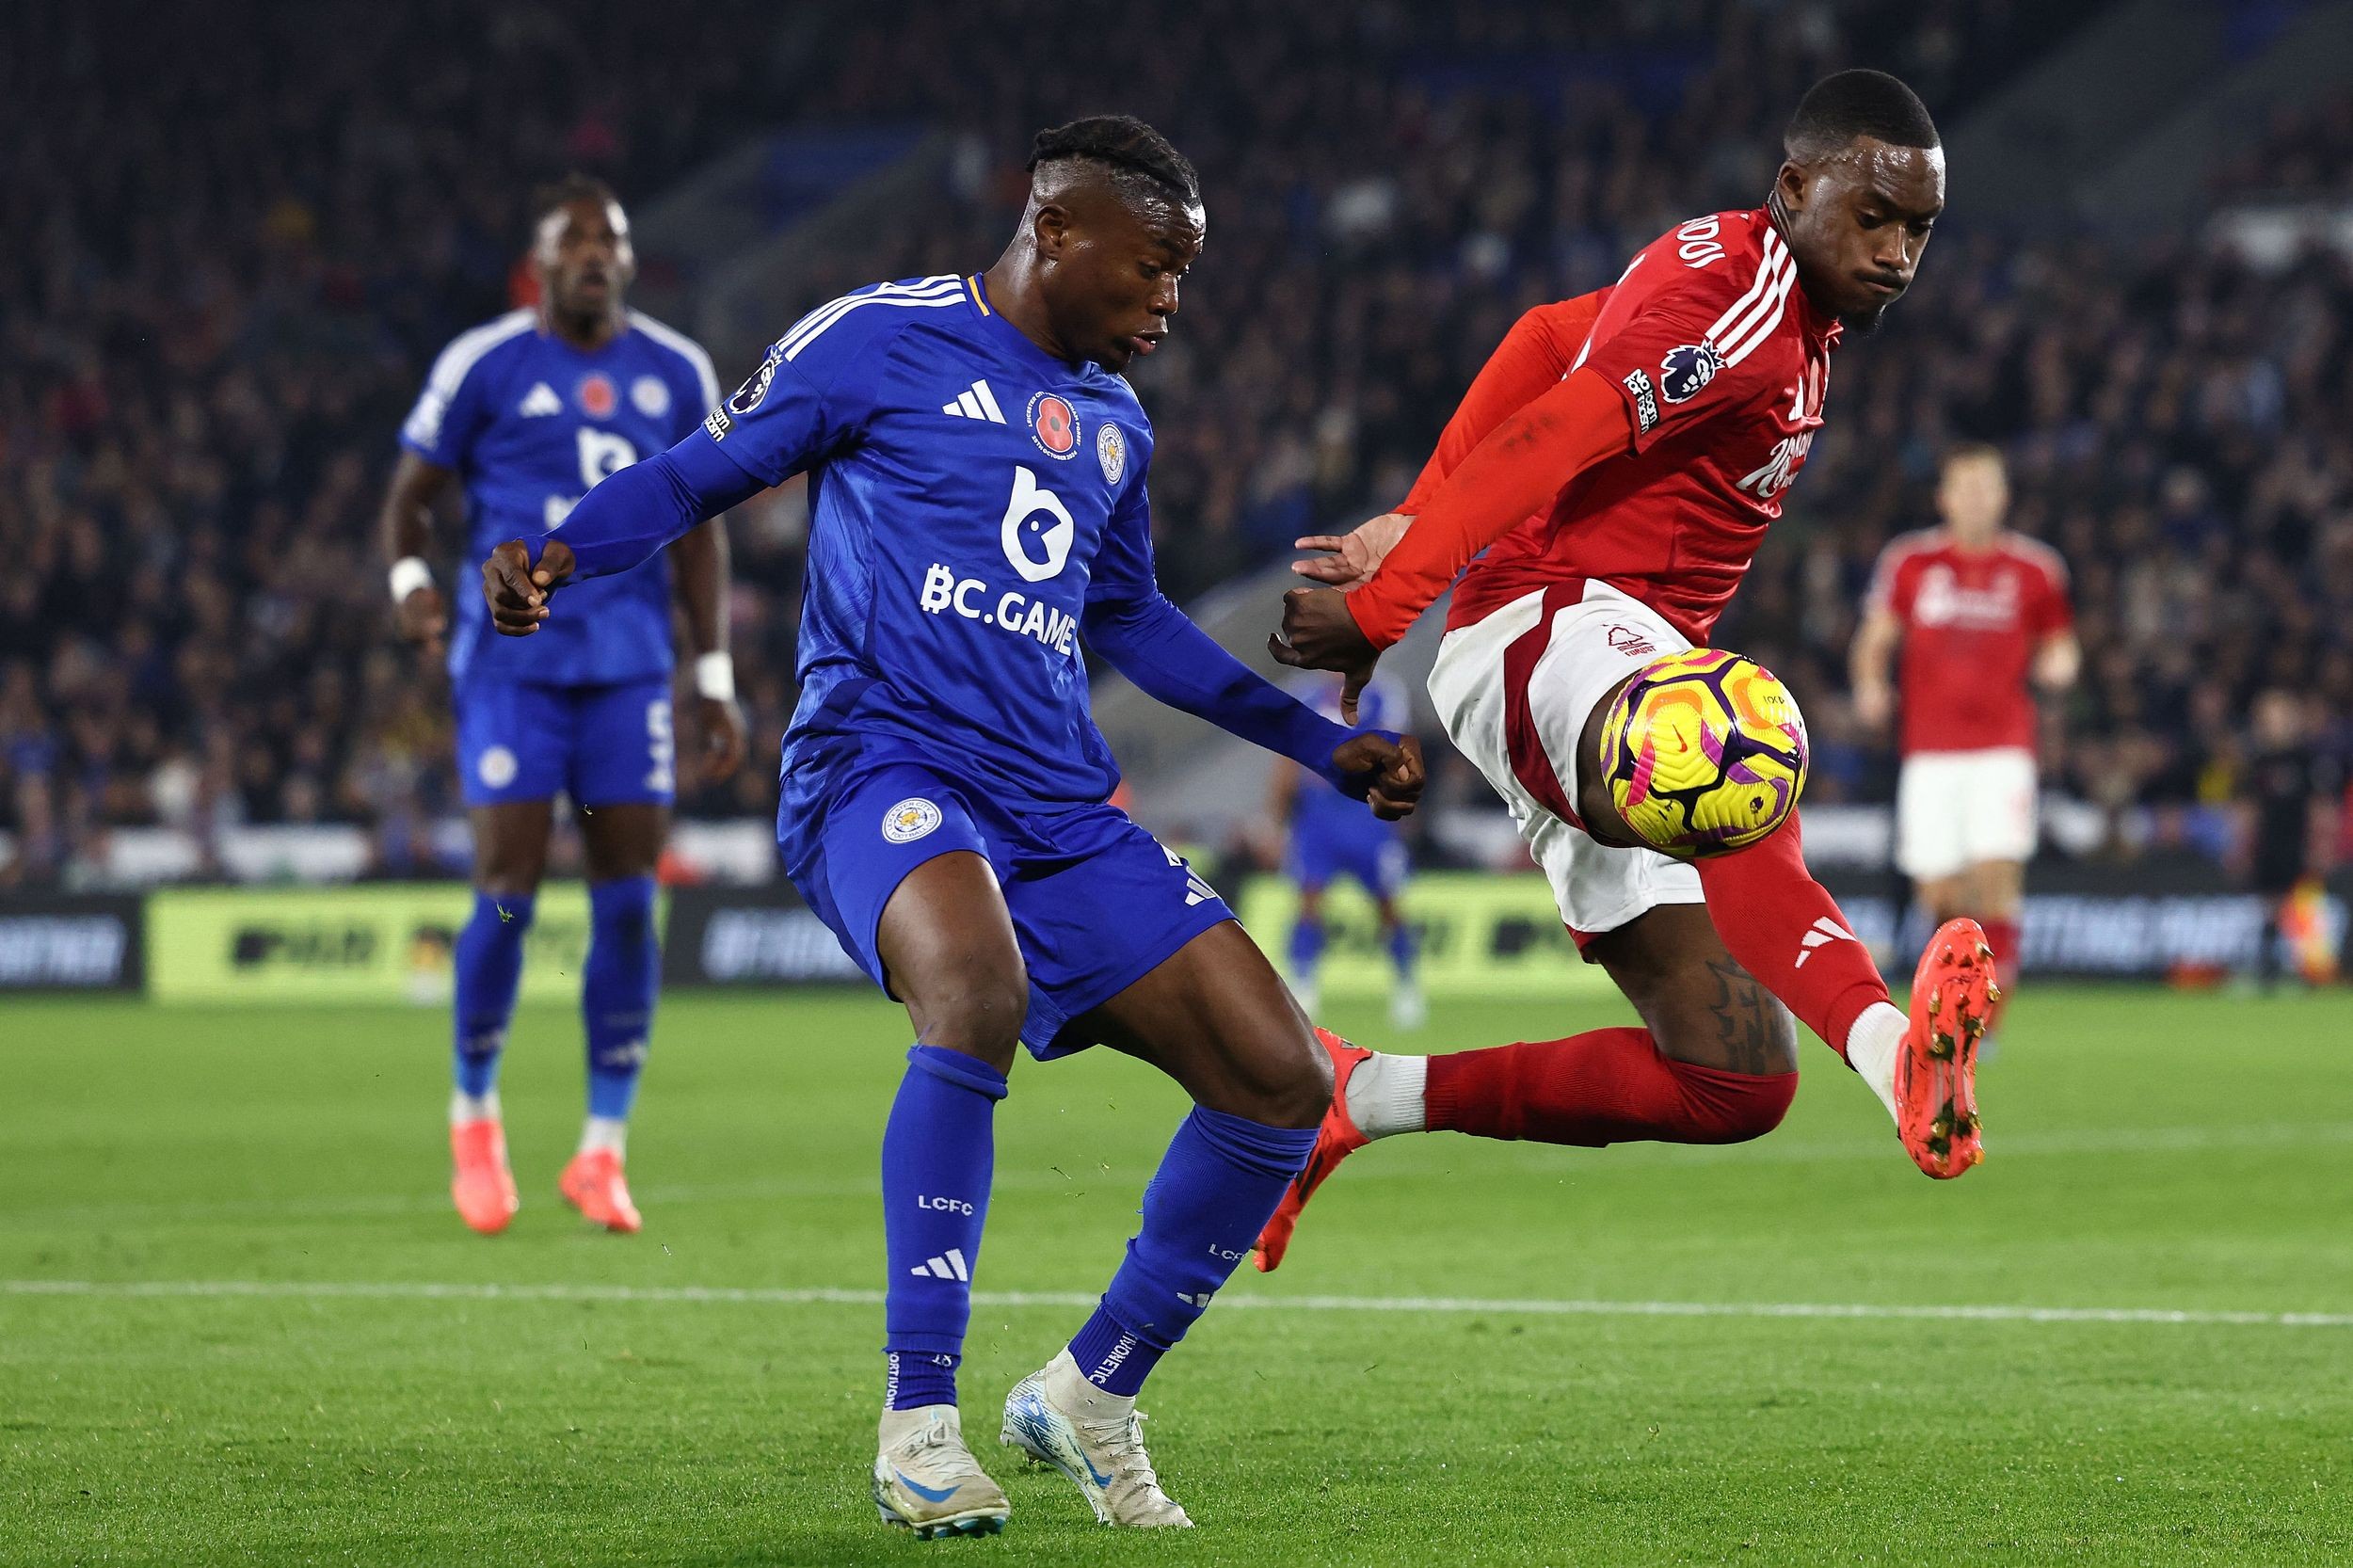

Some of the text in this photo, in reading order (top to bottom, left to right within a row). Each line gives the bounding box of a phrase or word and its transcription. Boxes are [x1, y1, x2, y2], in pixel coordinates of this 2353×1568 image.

[1026, 395, 1037, 427] LEICESTER
[918, 1194, 973, 1216] LCFC
[885, 1352, 900, 1411] ORTIVON
